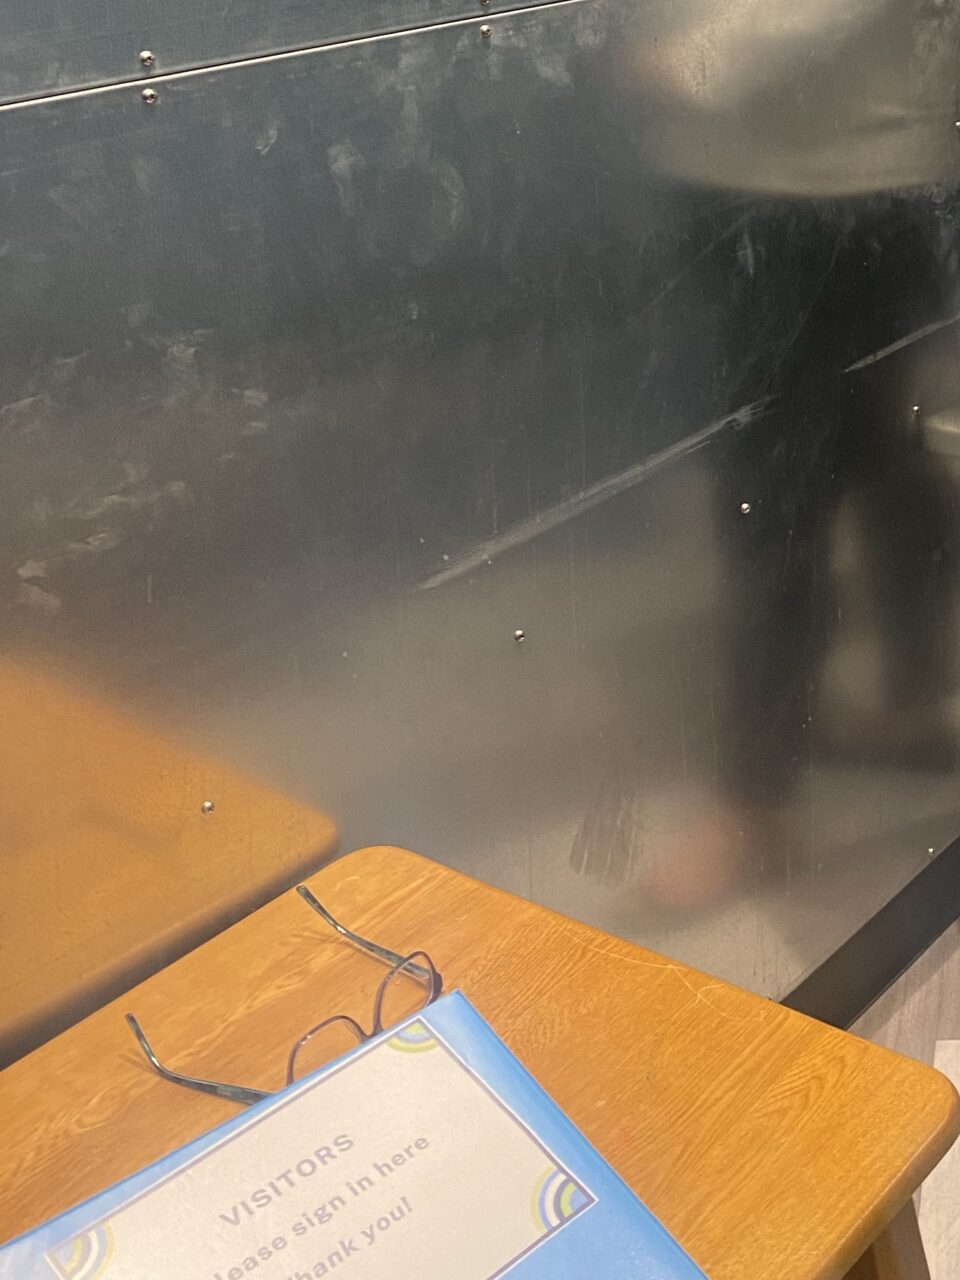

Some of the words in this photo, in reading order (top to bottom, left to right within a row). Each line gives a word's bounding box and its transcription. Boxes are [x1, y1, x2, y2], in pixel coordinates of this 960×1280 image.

[219, 1134, 354, 1226] VISITORS
[291, 1195, 346, 1236] sign
[346, 1176, 374, 1197] in
[373, 1137, 430, 1178] here
[287, 1238, 360, 1280] hank
[361, 1196, 413, 1246] you!
